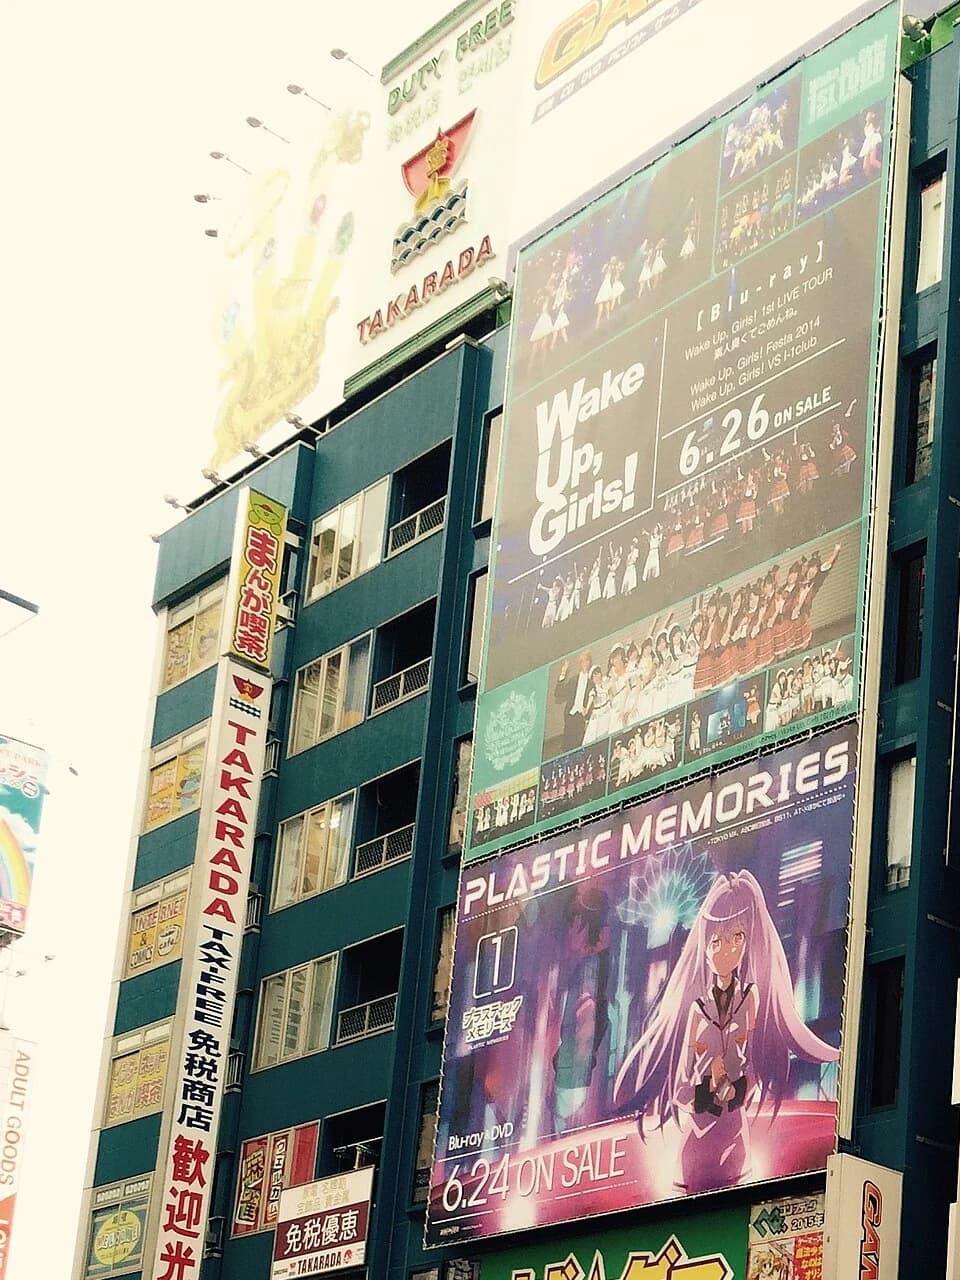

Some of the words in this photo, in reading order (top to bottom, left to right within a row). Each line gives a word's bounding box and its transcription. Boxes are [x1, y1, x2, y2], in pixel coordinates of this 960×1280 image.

[388, 48, 448, 116] DUTY
[454, 0, 516, 63] FREE
[356, 234, 497, 346] TAKARADA
[684, 340, 711, 361] Wake
[802, 267, 833, 293] TOUR
[690, 374, 716, 397] Wake
[766, 333, 793, 354] Festa
[795, 315, 821, 339] 2014
[536, 358, 645, 447] Wake
[690, 391, 716, 412] Wake
[773, 406, 793, 429] ON
[795, 386, 832, 418] SALE
[528, 452, 638, 557] Girls!
[235, 527, 280, 661] まんが喫茶
[202, 719, 257, 924] TAKARADA
[464, 838, 613, 917] PLASTIC
[620, 741, 851, 860] MEMORIES
[139, 932, 148, 947] &
[9, 1049, 31, 1112] ADULT
[177, 1028, 223, 1133] 免税商店
[442, 1153, 511, 1213] 6.24
[515, 1154, 556, 1197] ON
[560, 1135, 628, 1189] SALE
[448, 1129, 484, 1151] Blu-ray
[492, 1122, 514, 1142] DVD
[297, 1251, 342, 1275] TAKARADA
